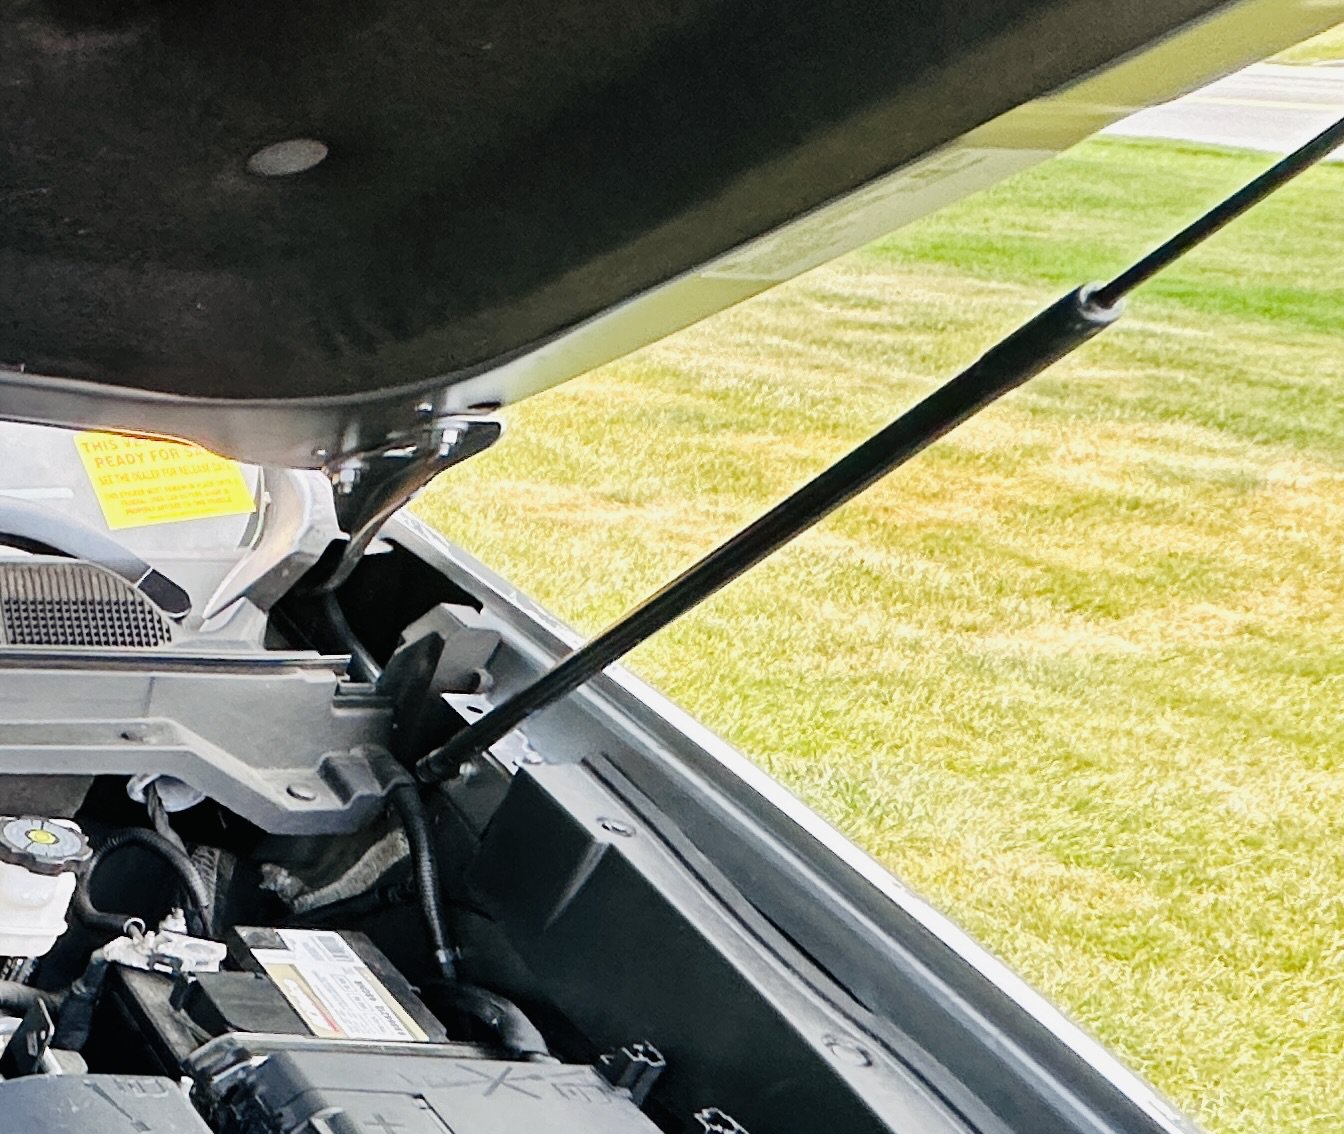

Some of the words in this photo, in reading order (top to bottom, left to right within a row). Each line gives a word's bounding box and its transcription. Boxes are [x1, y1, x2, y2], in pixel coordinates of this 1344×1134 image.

[80, 439, 118, 453] THIS
[95, 452, 144, 468] READY
[150, 447, 180, 462] FOR
